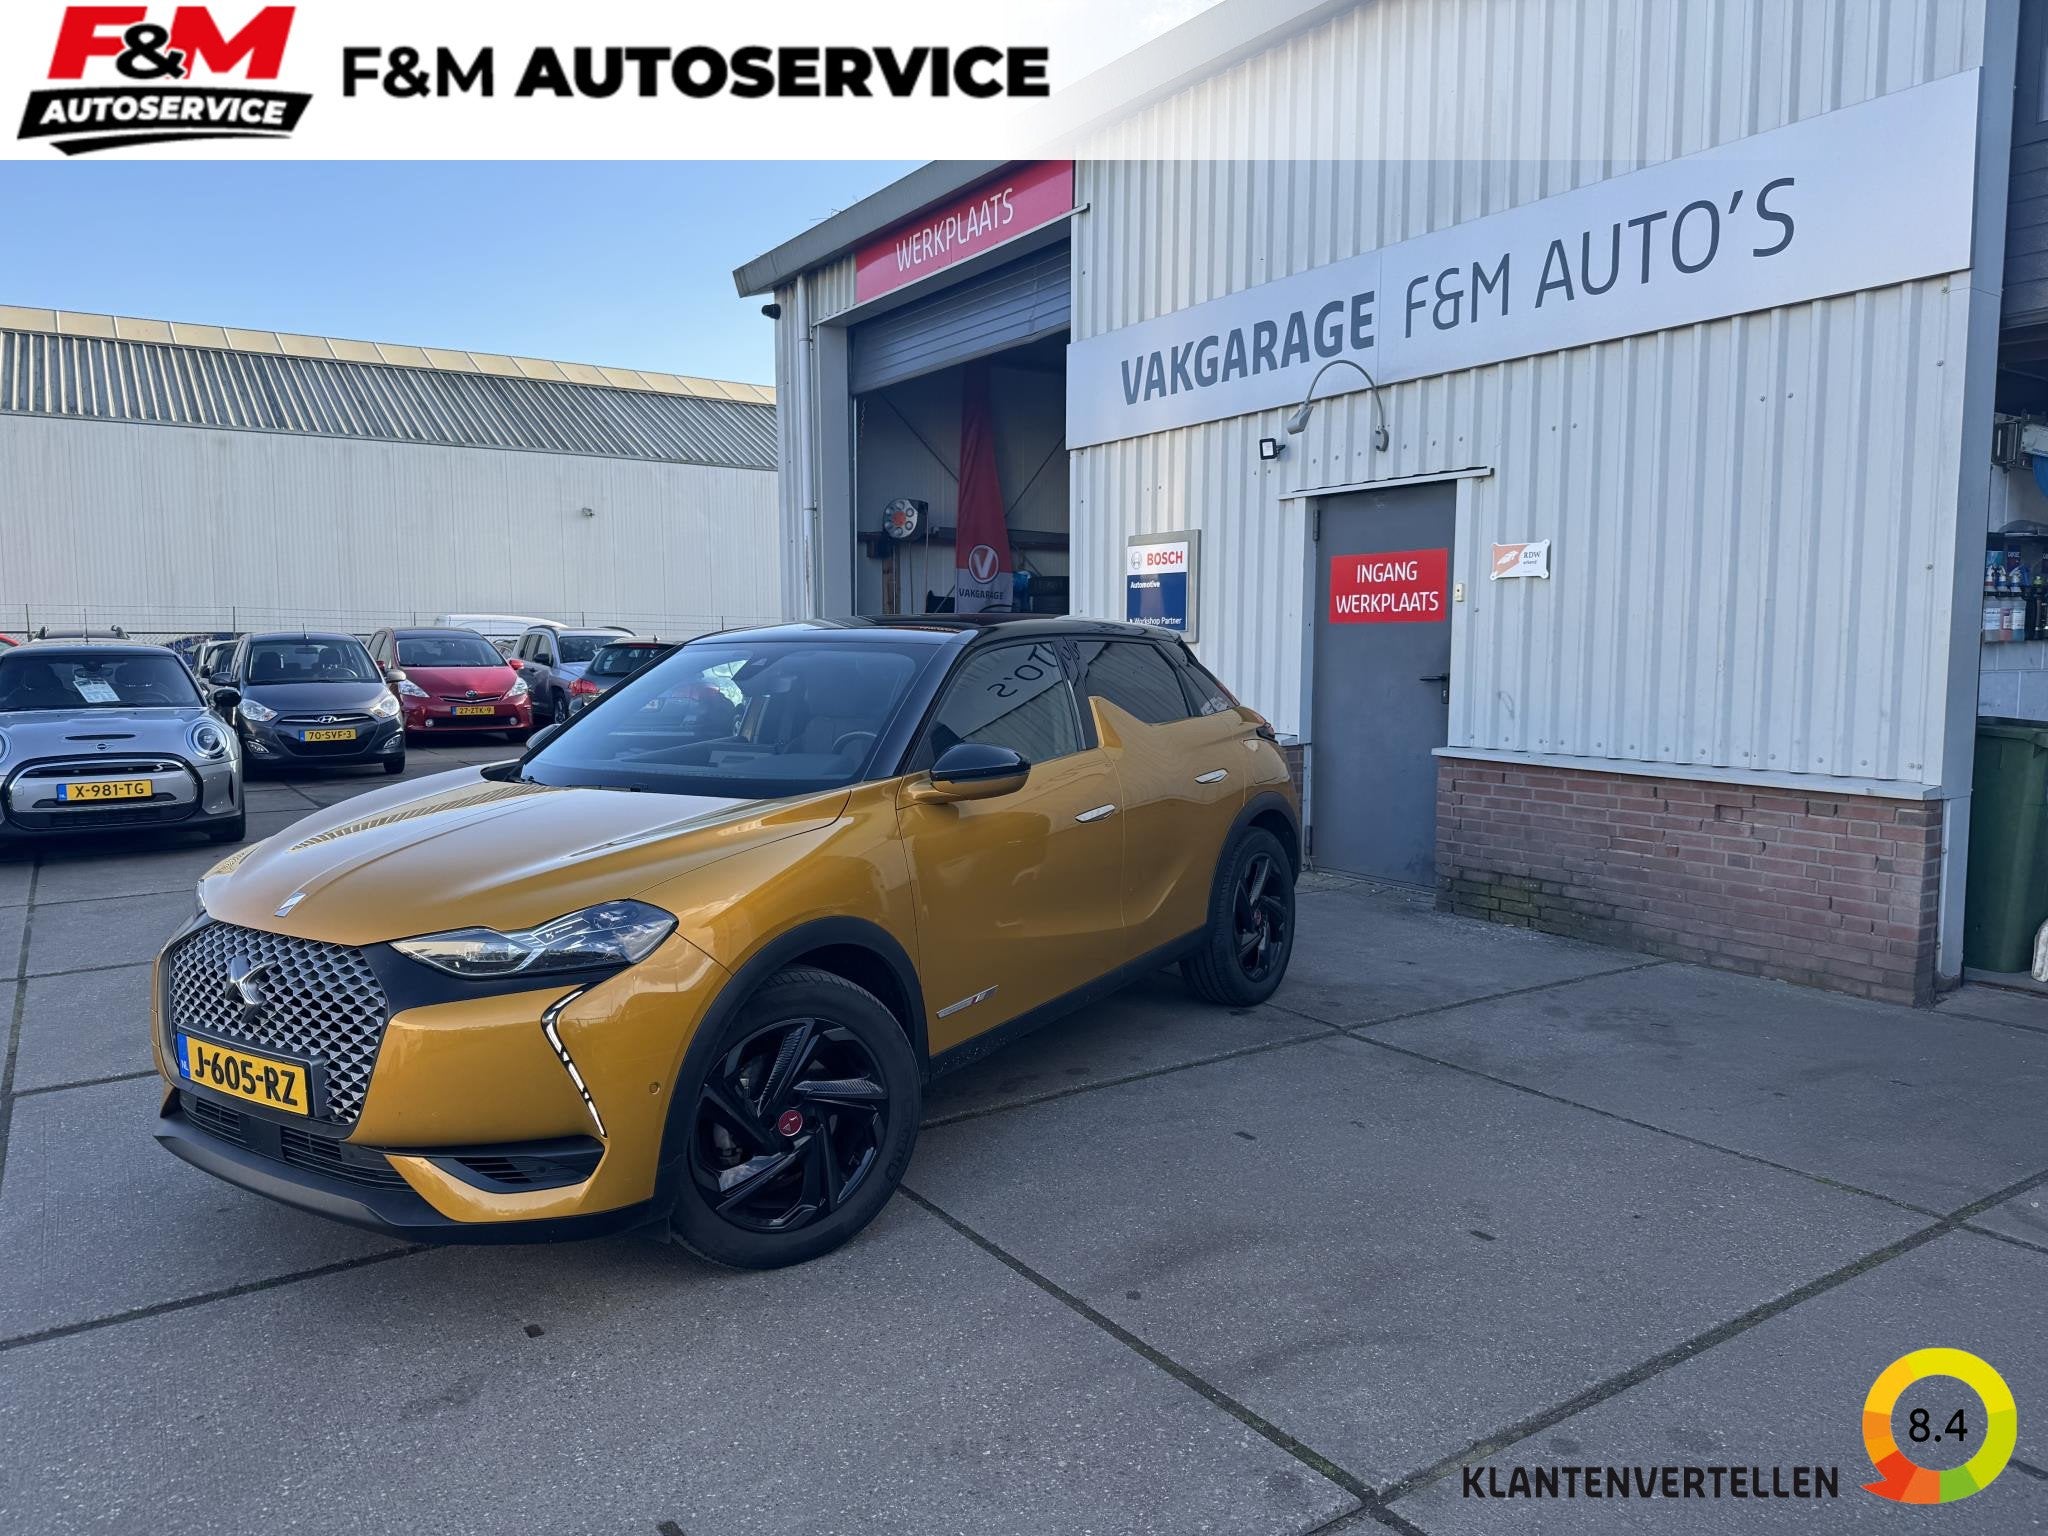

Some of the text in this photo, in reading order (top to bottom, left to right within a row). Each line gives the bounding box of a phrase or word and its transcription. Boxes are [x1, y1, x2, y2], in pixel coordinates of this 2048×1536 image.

[895, 187, 1014, 273] WERKPLAATS
[1119, 177, 1796, 406] VAKGARAGE F&M AUTO'S
[1146, 551, 1183, 566] BOSCH
[1356, 561, 1418, 583] INGANG
[1130, 580, 1160, 589] Automotive
[959, 588, 1004, 600] VAKGARAGE
[1336, 591, 1439, 614] WERKPLAATS
[1134, 616, 1182, 626] Workshop Partner
[309, 731, 352, 740] 70-SVF-3
[75, 783, 144, 798] X-981-TG
[195, 1046, 298, 1106] J-605-RZ
